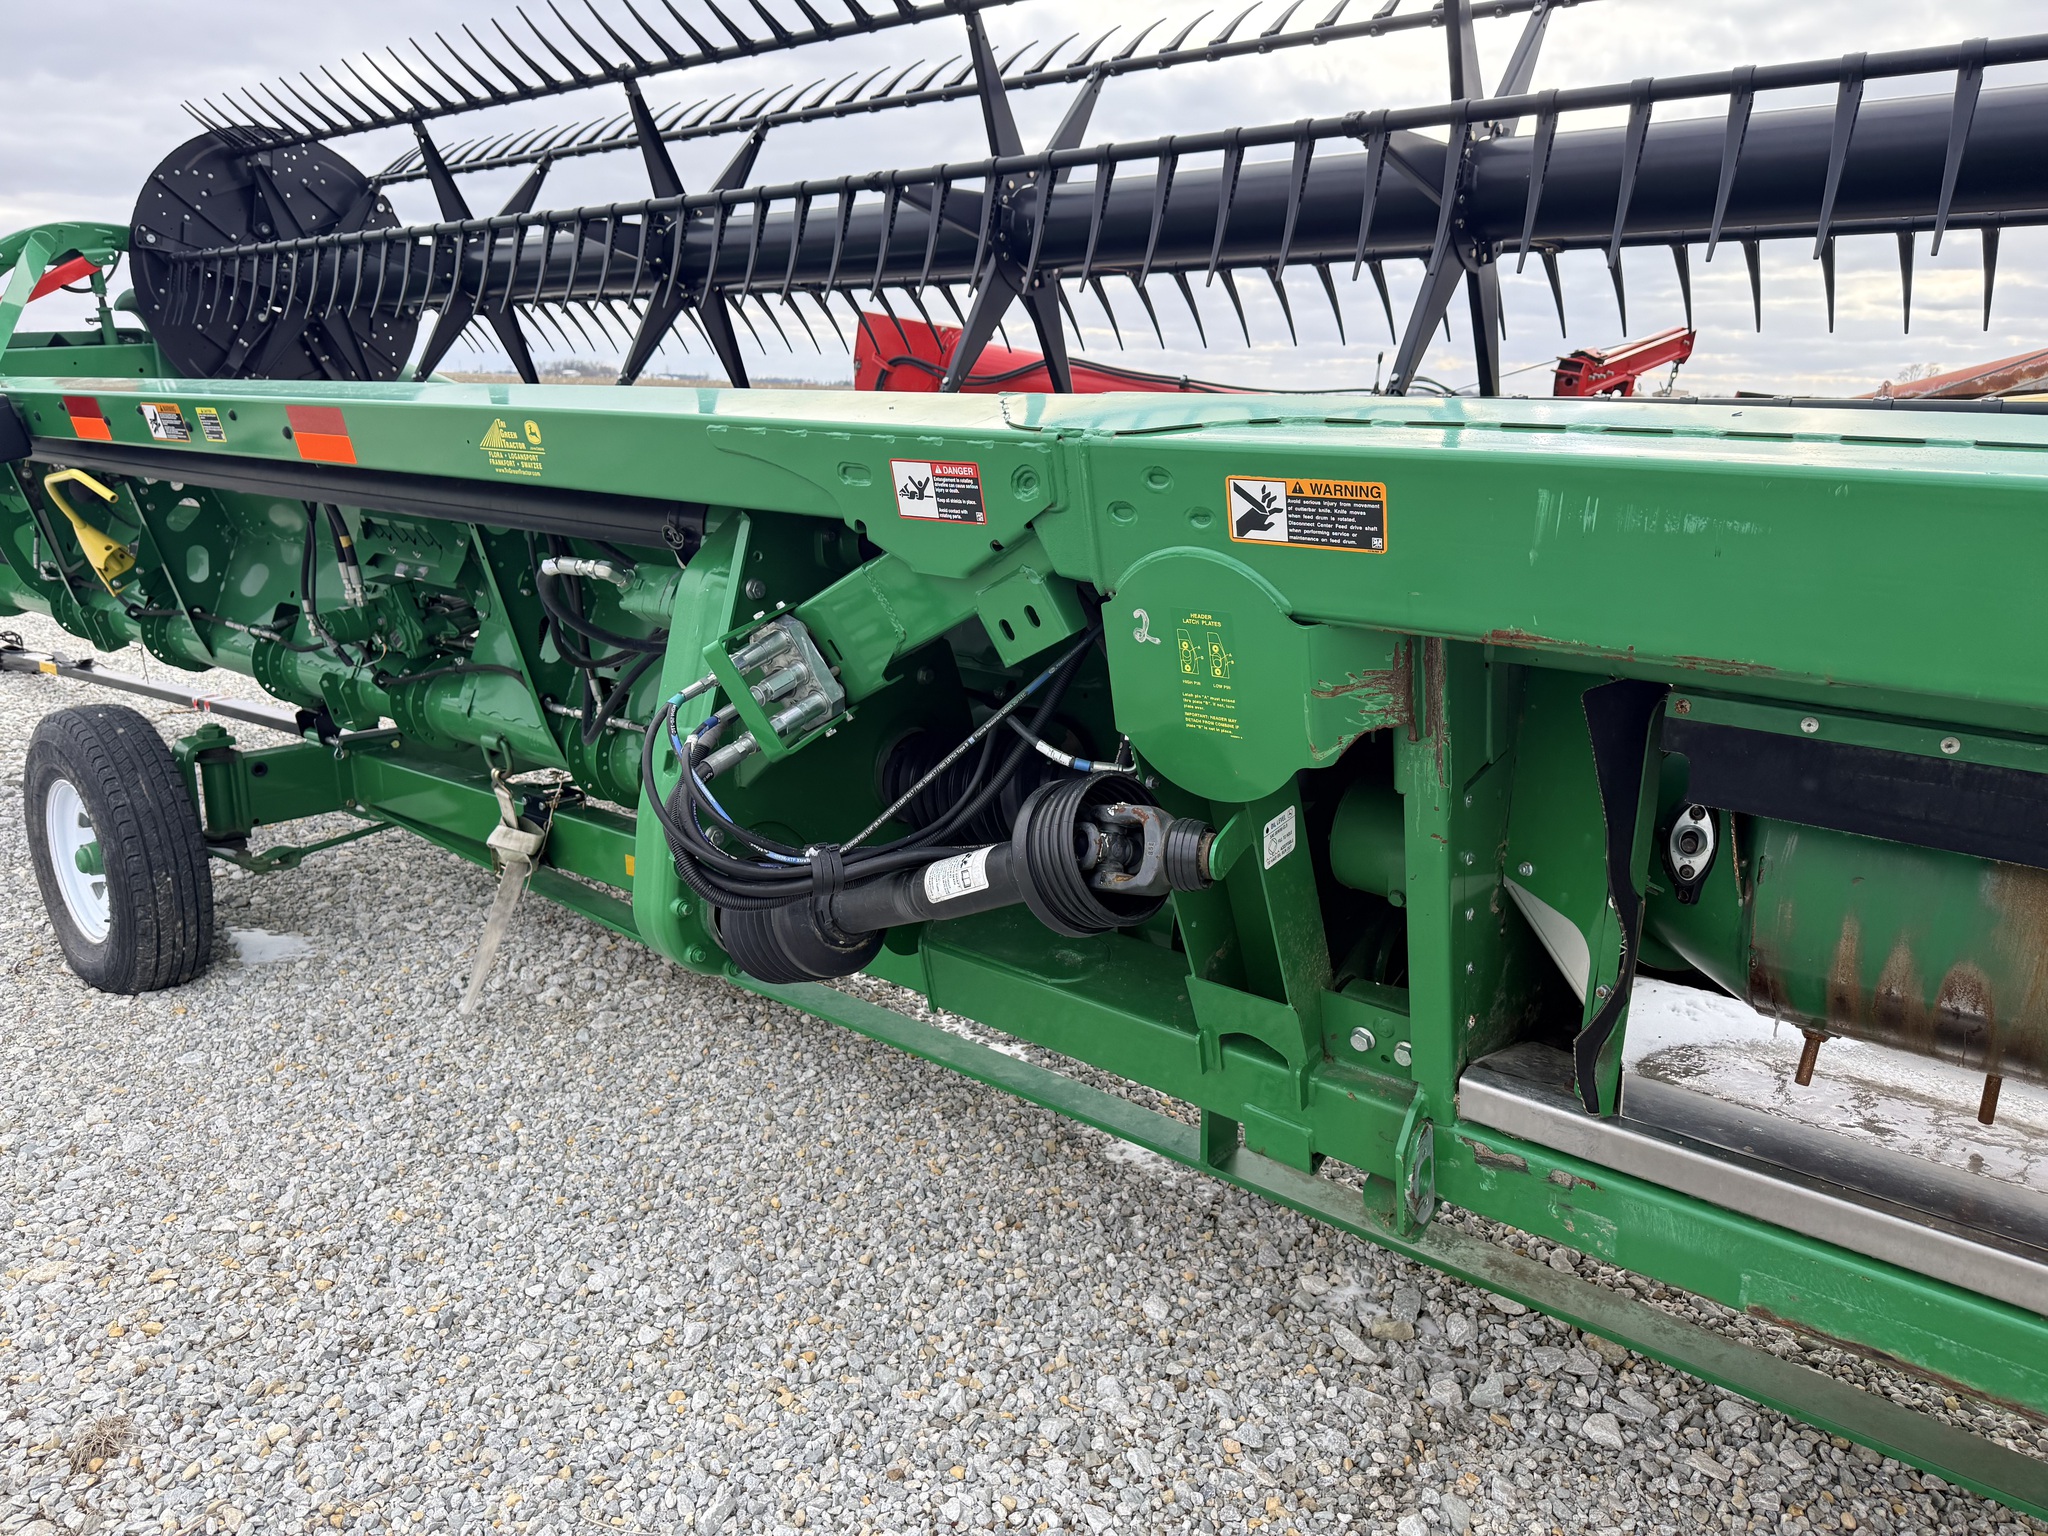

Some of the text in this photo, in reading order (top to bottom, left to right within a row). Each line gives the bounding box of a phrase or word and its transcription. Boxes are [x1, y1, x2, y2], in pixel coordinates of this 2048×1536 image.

[500, 428, 518, 439] GREEN
[502, 439, 526, 449] TRACTOR
[508, 452, 538, 461] LOGANSPORT
[489, 458, 542, 470] FRANKFORT SWAYZEE
[943, 466, 973, 475] DANGER
[1310, 483, 1381, 498] WARNING
[1133, 608, 1161, 645] 2
[974, 727, 986, 738] Flame
[986, 714, 1003, 729] Resistant
[1277, 814, 1286, 826] LEVEL
